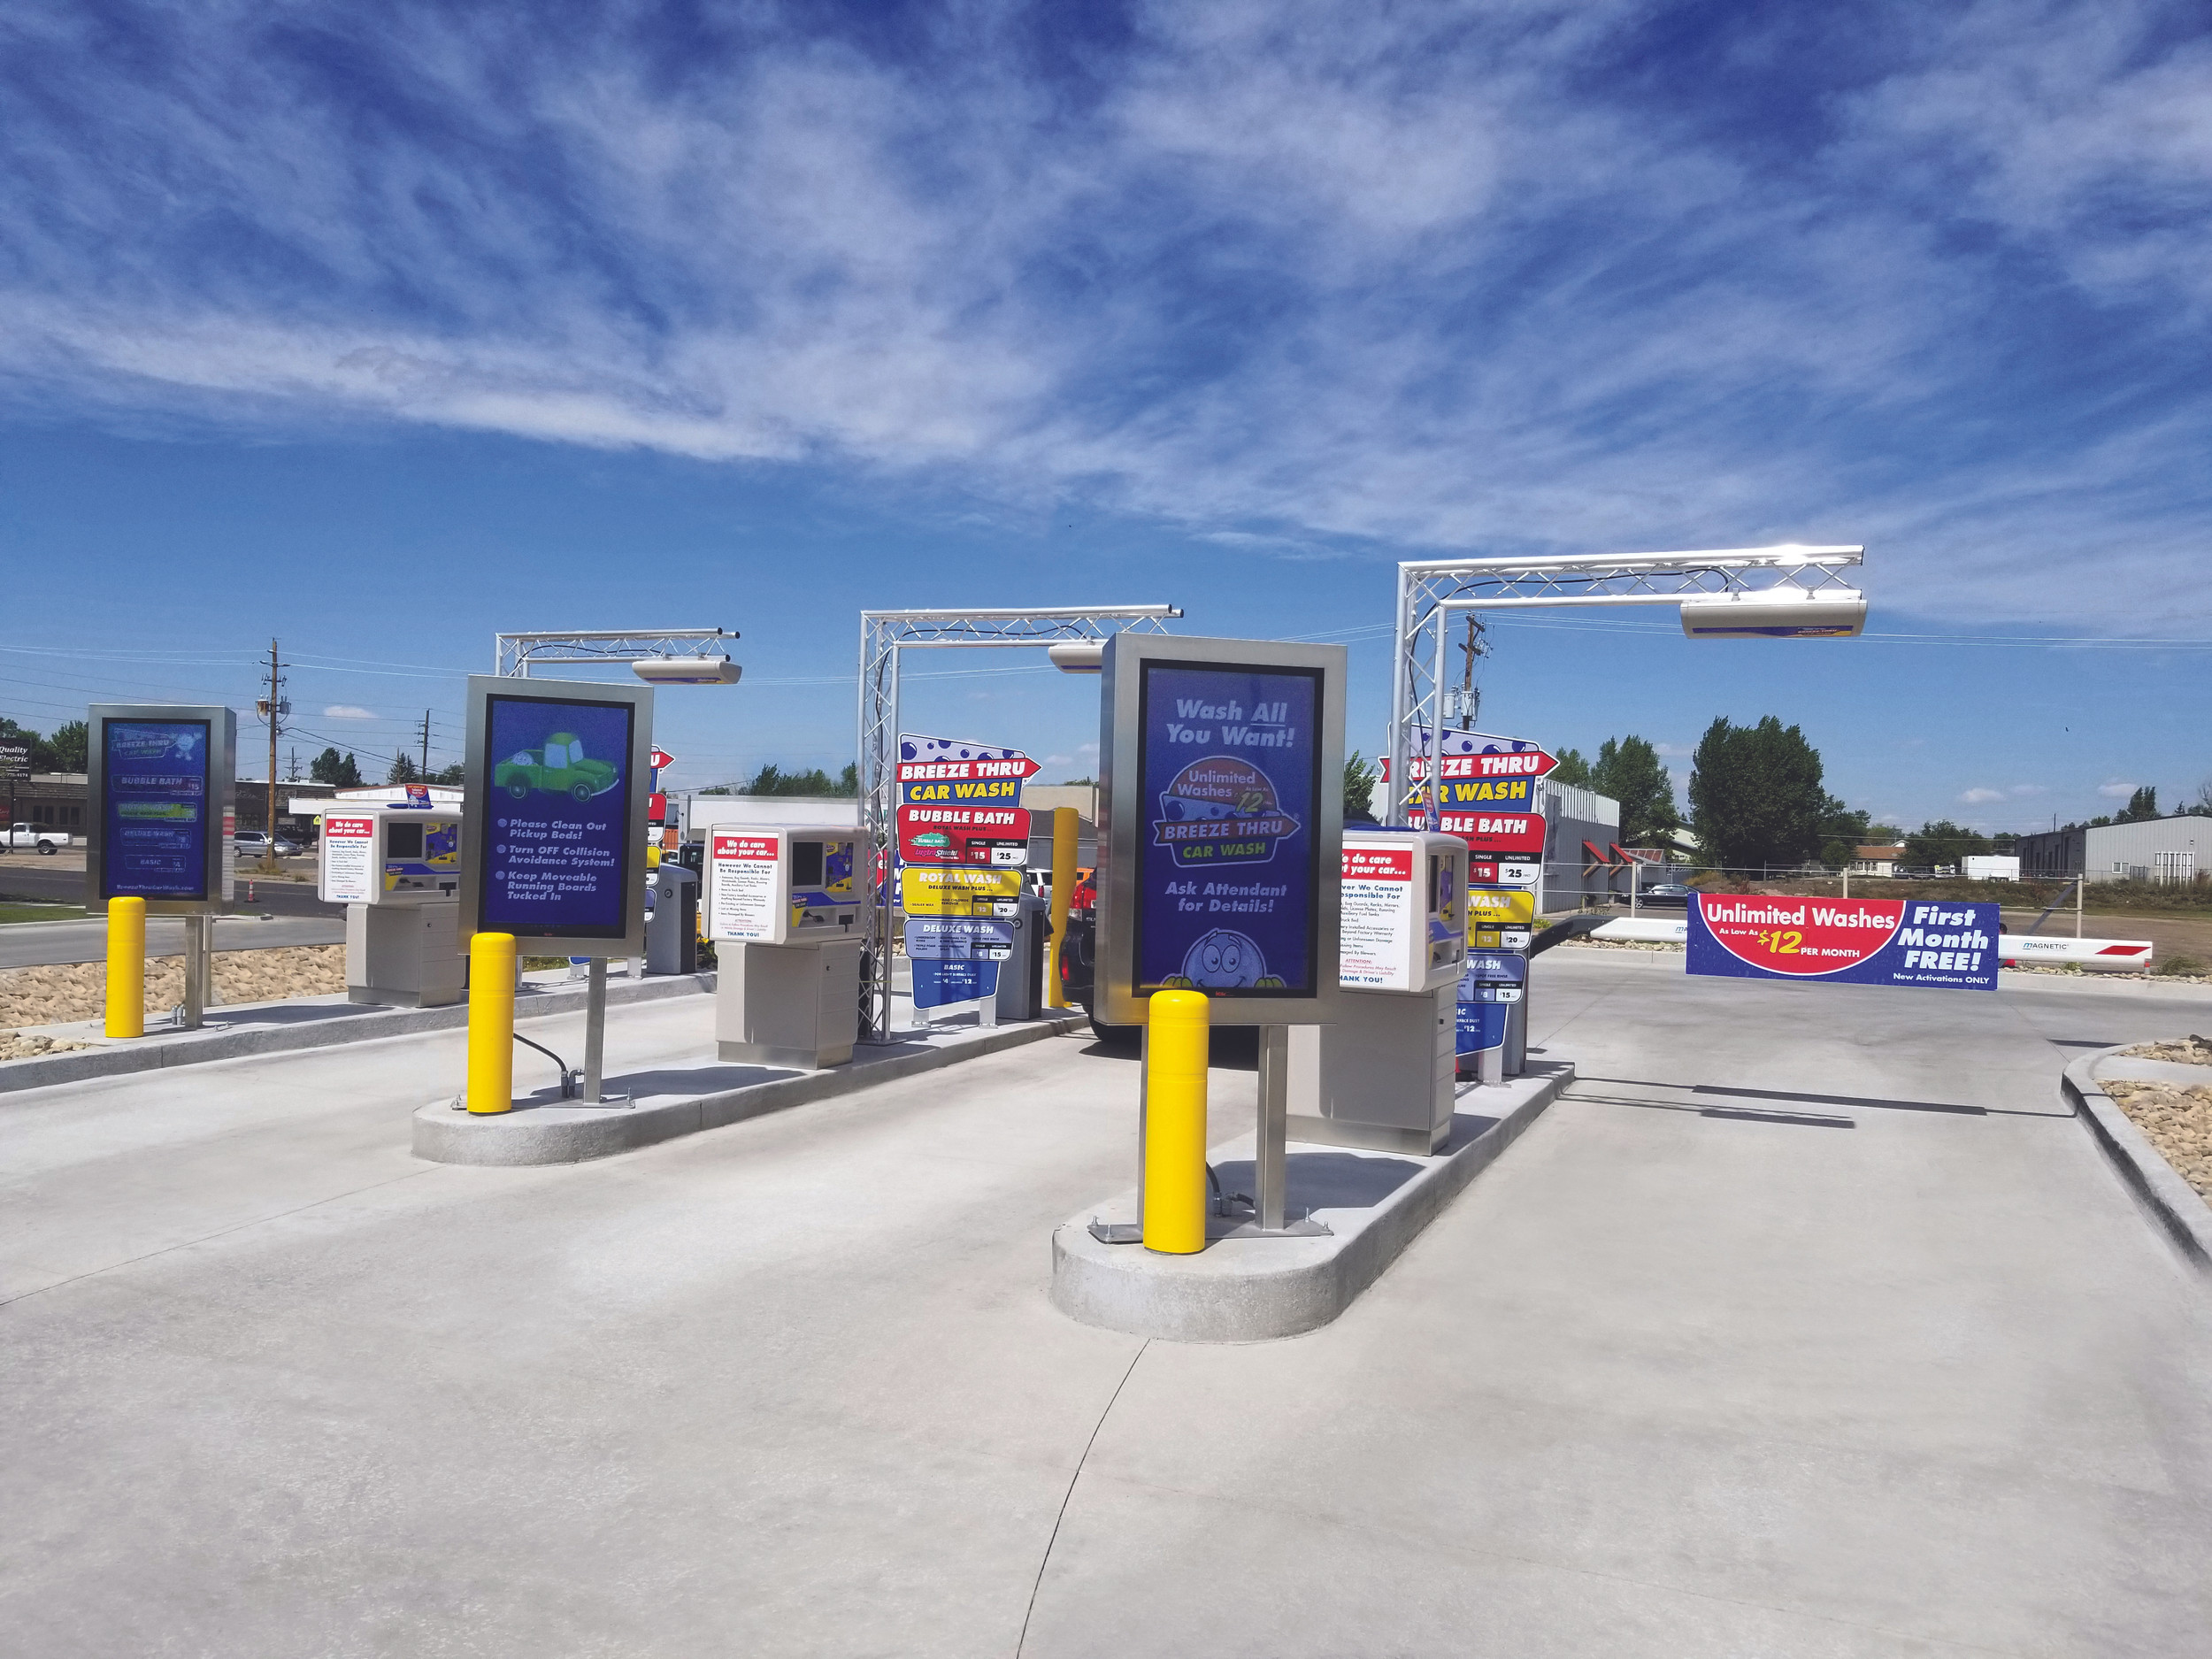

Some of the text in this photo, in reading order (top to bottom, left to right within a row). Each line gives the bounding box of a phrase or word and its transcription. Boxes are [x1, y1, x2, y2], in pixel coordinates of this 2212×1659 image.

[1176, 699, 1287, 722] Wash All
[1166, 724, 1295, 748] You Want!
[0, 746, 27, 755] Quality
[901, 761, 1025, 780] BREEZE THRU
[1409, 756, 1539, 777] REZE THRU
[1189, 770, 1256, 784] Unlimited
[910, 782, 1015, 801] CAR WASH
[1177, 783, 1232, 797] Washes
[1454, 781, 1527, 802] WASH
[909, 810, 1015, 824] BUBBLE BATH
[510, 819, 607, 831] Please Clean Out
[1164, 820, 1282, 839] BREEZE THRU
[1409, 816, 1528, 834] UBLE BATH
[510, 829, 583, 840] Pickup Beds!
[509, 845, 610, 857] Turn OFF Collision
[717, 847, 737, 855] about
[971, 851, 1011, 860] $15 $25
[1183, 842, 1266, 859] CAR WASH
[508, 855, 615, 867] Avoidance System!
[1342, 854, 1349, 863] e
[1352, 853, 1366, 863] do
[508, 871, 597, 882] Keep Moveable
[1351, 866, 1375, 875] your
[1473, 868, 1522, 878] $15 $25
[919, 872, 1002, 884] ROYAL WASH
[508, 881, 596, 892] Running Boards
[1165, 881, 1287, 896] Ask Attendant
[508, 891, 561, 901] Tucked In
[1468, 895, 1511, 908] WASH
[1178, 898, 1274, 913] for Details!
[1707, 903, 1895, 929] Unlimited Washes
[1913, 906, 1976, 926] First
[923, 925, 994, 934] DELUXE WASH
[1757, 930, 1802, 954] $12
[1897, 928, 1989, 949] Month
[1800, 947, 1860, 958] PER MONTH
[1467, 959, 1501, 969] WASH
[1904, 950, 1981, 972] FREE!
[1916, 974, 1963, 983] Activations
[1965, 976, 1990, 984] ONLY
